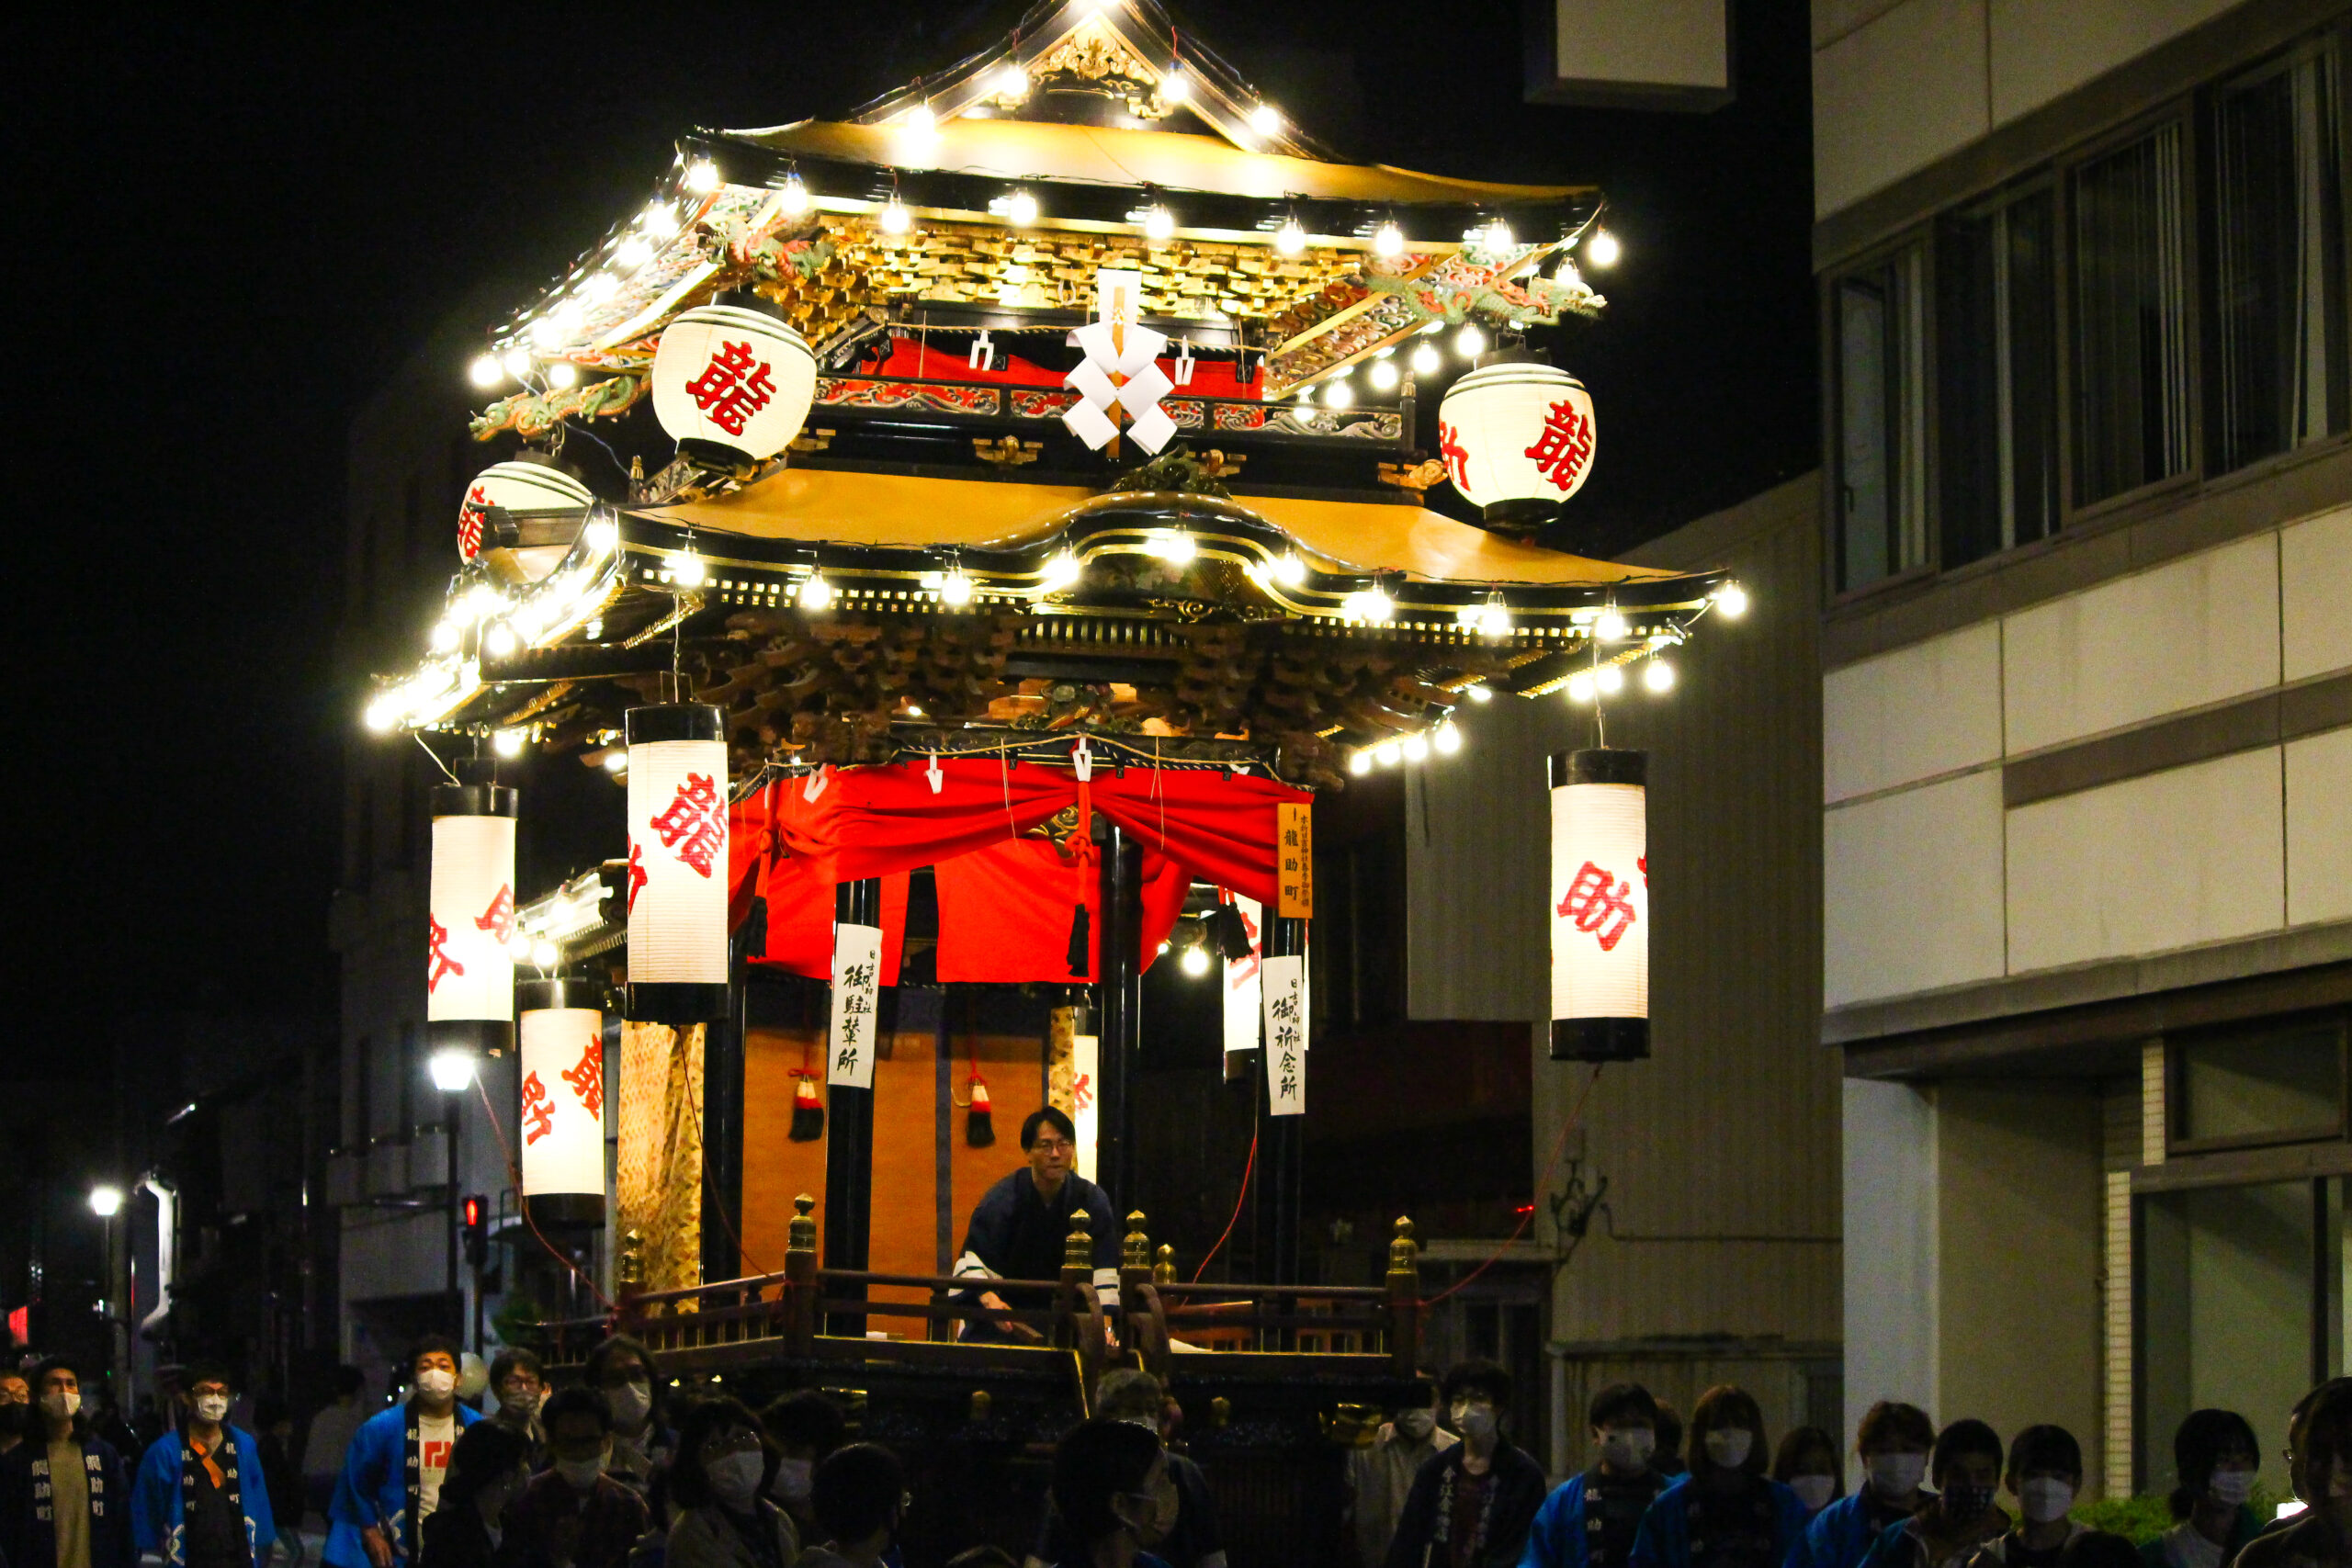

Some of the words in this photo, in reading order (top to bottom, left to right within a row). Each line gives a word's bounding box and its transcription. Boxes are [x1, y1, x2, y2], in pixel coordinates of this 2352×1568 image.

[684, 339, 776, 436] 龍
[1524, 400, 1593, 491] 龍
[650, 772, 729, 879] 龍
[1556, 860, 1636, 952] 助
[1272, 997, 1298, 1100] 御祈念所
